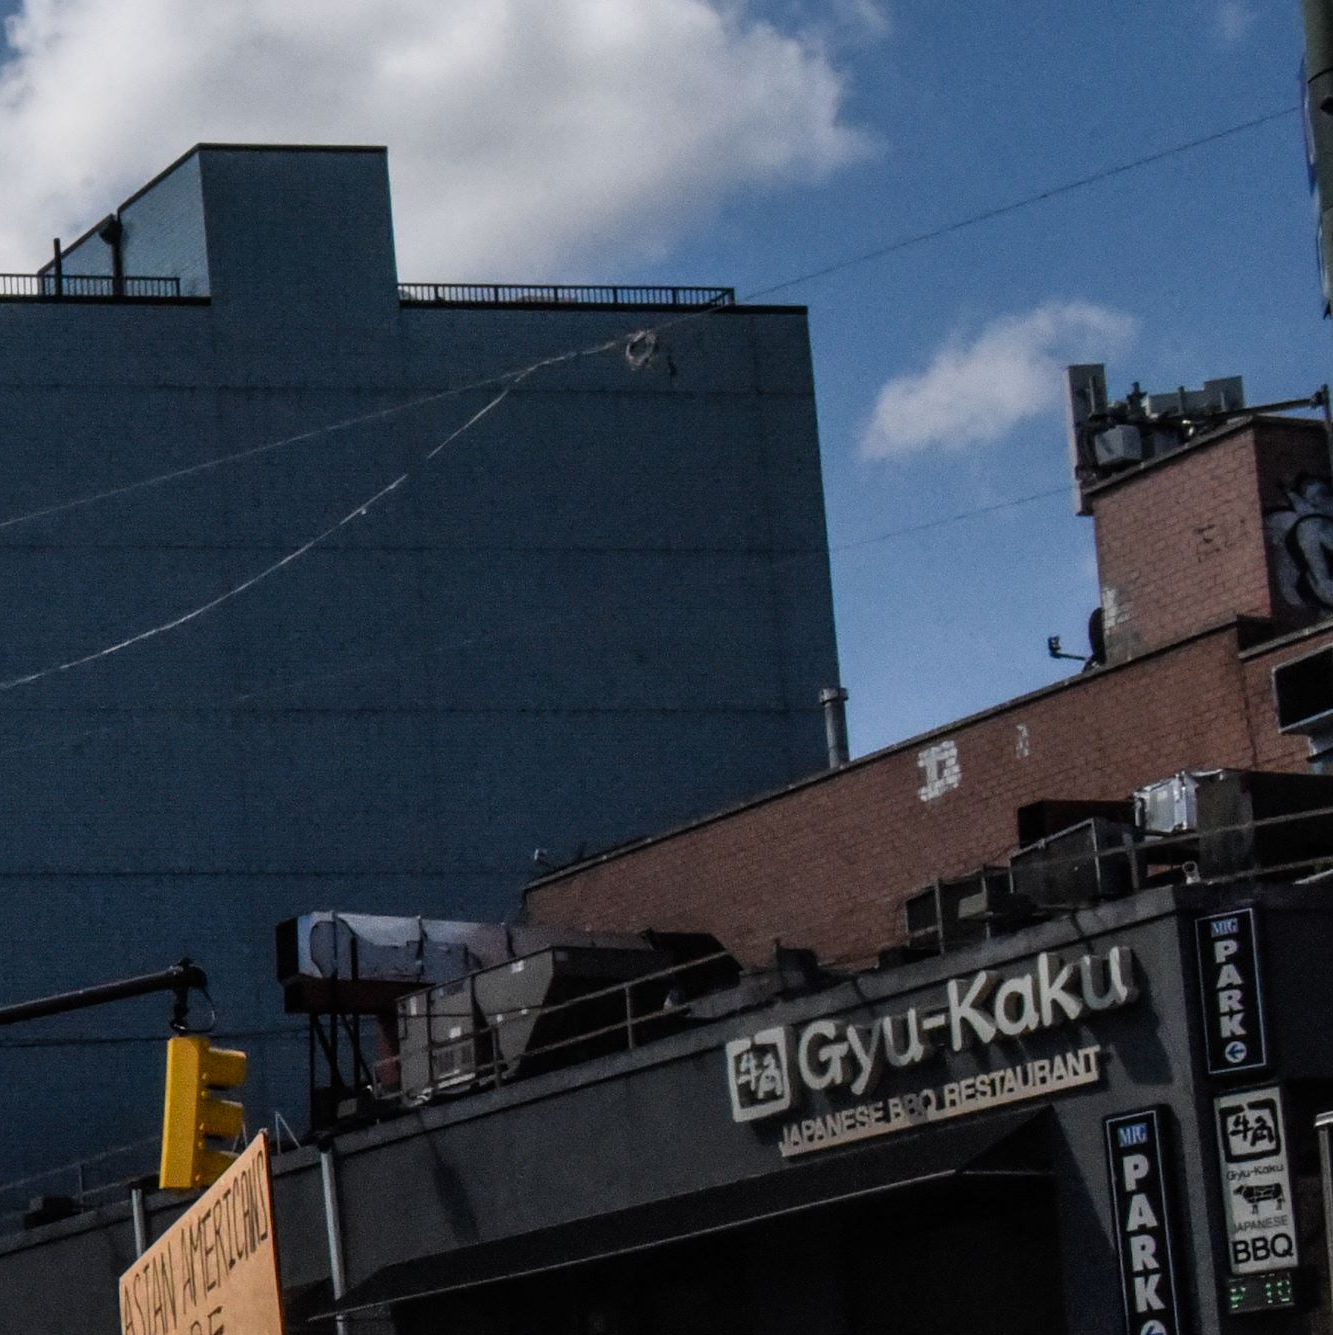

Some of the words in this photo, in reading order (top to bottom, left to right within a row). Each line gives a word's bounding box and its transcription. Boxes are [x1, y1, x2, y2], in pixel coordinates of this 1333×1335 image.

[798, 946, 1130, 1095] Gyu-Kaku
[1213, 940, 1247, 1039] PARK
[780, 1105, 884, 1152] JAPANESE
[889, 1088, 936, 1124] BBQ
[943, 1045, 1100, 1109] RESTAURANT
[1226, 1164, 1284, 1182] Gyu-Kaku
[1232, 1214, 1289, 1233] JAPANESE
[181, 1150, 269, 1315] AMERICANS
[1121, 1153, 1165, 1315] PARK
[1232, 1233, 1294, 1265] BBQ
